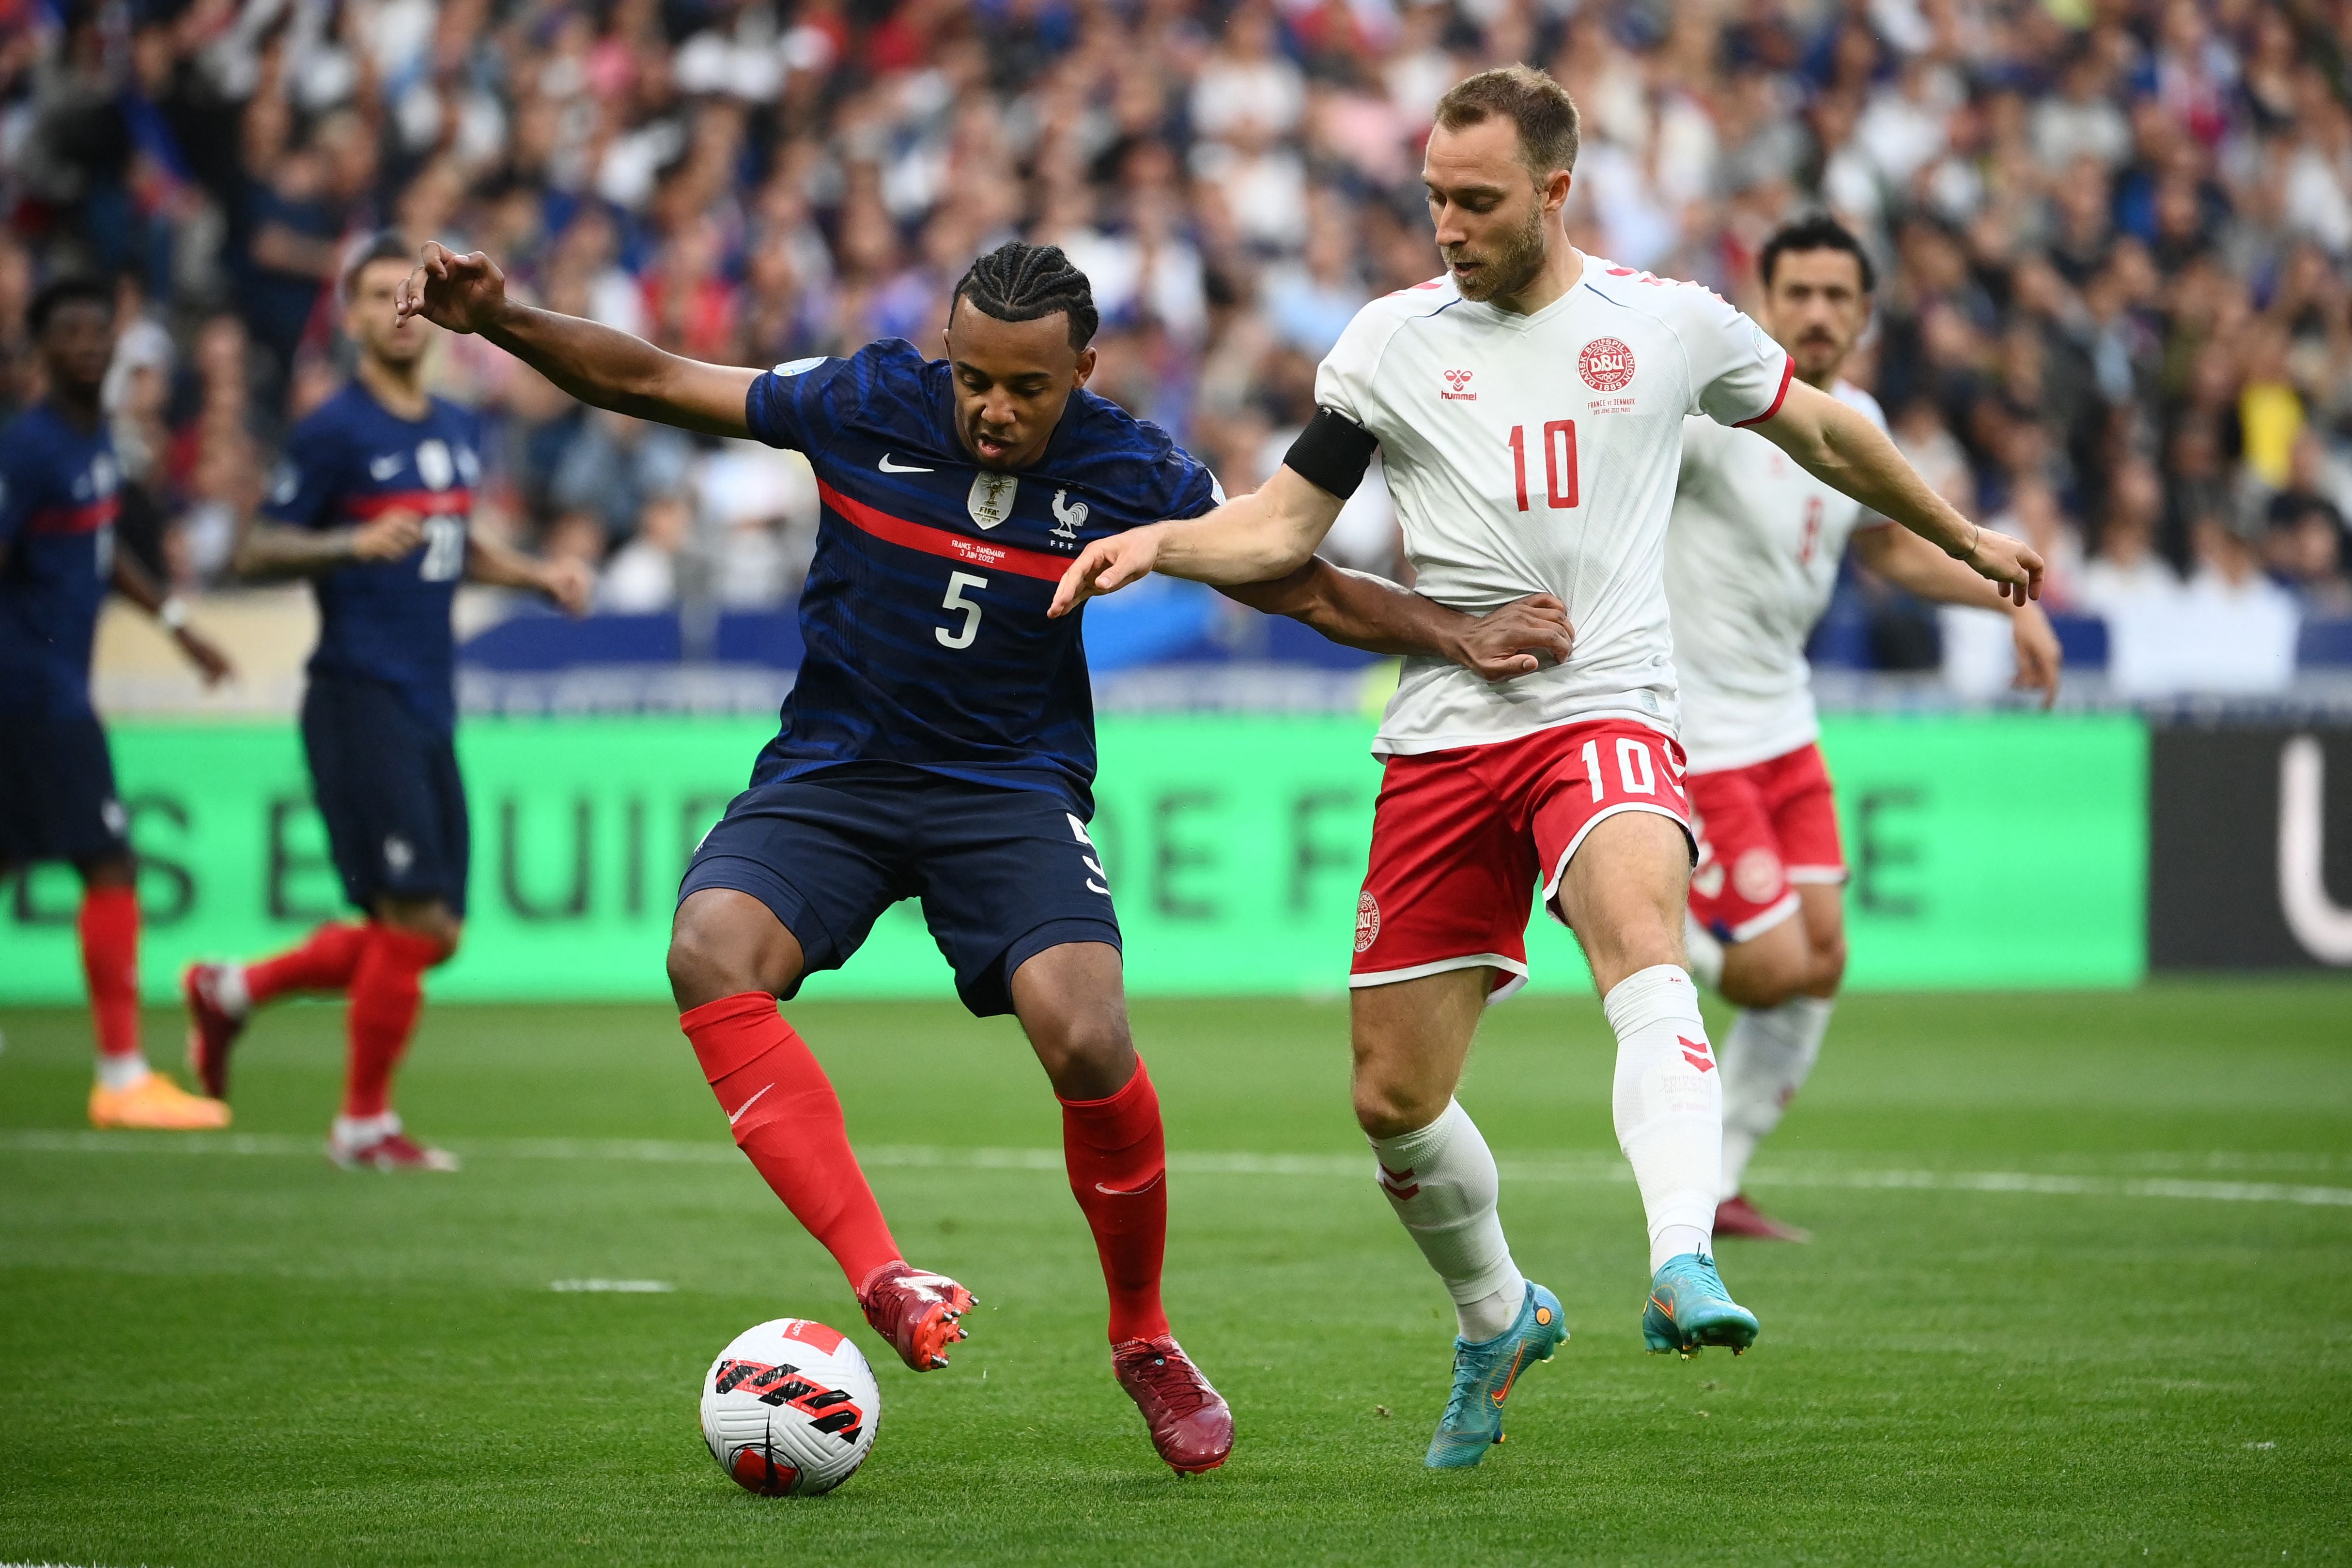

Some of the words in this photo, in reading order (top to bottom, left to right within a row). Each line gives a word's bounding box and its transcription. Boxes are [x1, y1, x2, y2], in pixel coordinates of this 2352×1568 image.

[1589, 354, 1625, 372] DBU
[1598, 381, 1622, 391] 1889
[1441, 390, 1477, 400] hummel
[1587, 400, 1606, 410] FRANCE
[1508, 419, 1578, 512] 10
[979, 506, 997, 516] FIFA
[951, 539, 972, 551] FRANCE
[976, 546, 1006, 559] DANEMARK
[978, 553, 994, 564] 2022
[935, 570, 988, 649] 5
[1581, 737, 1656, 804] 10
